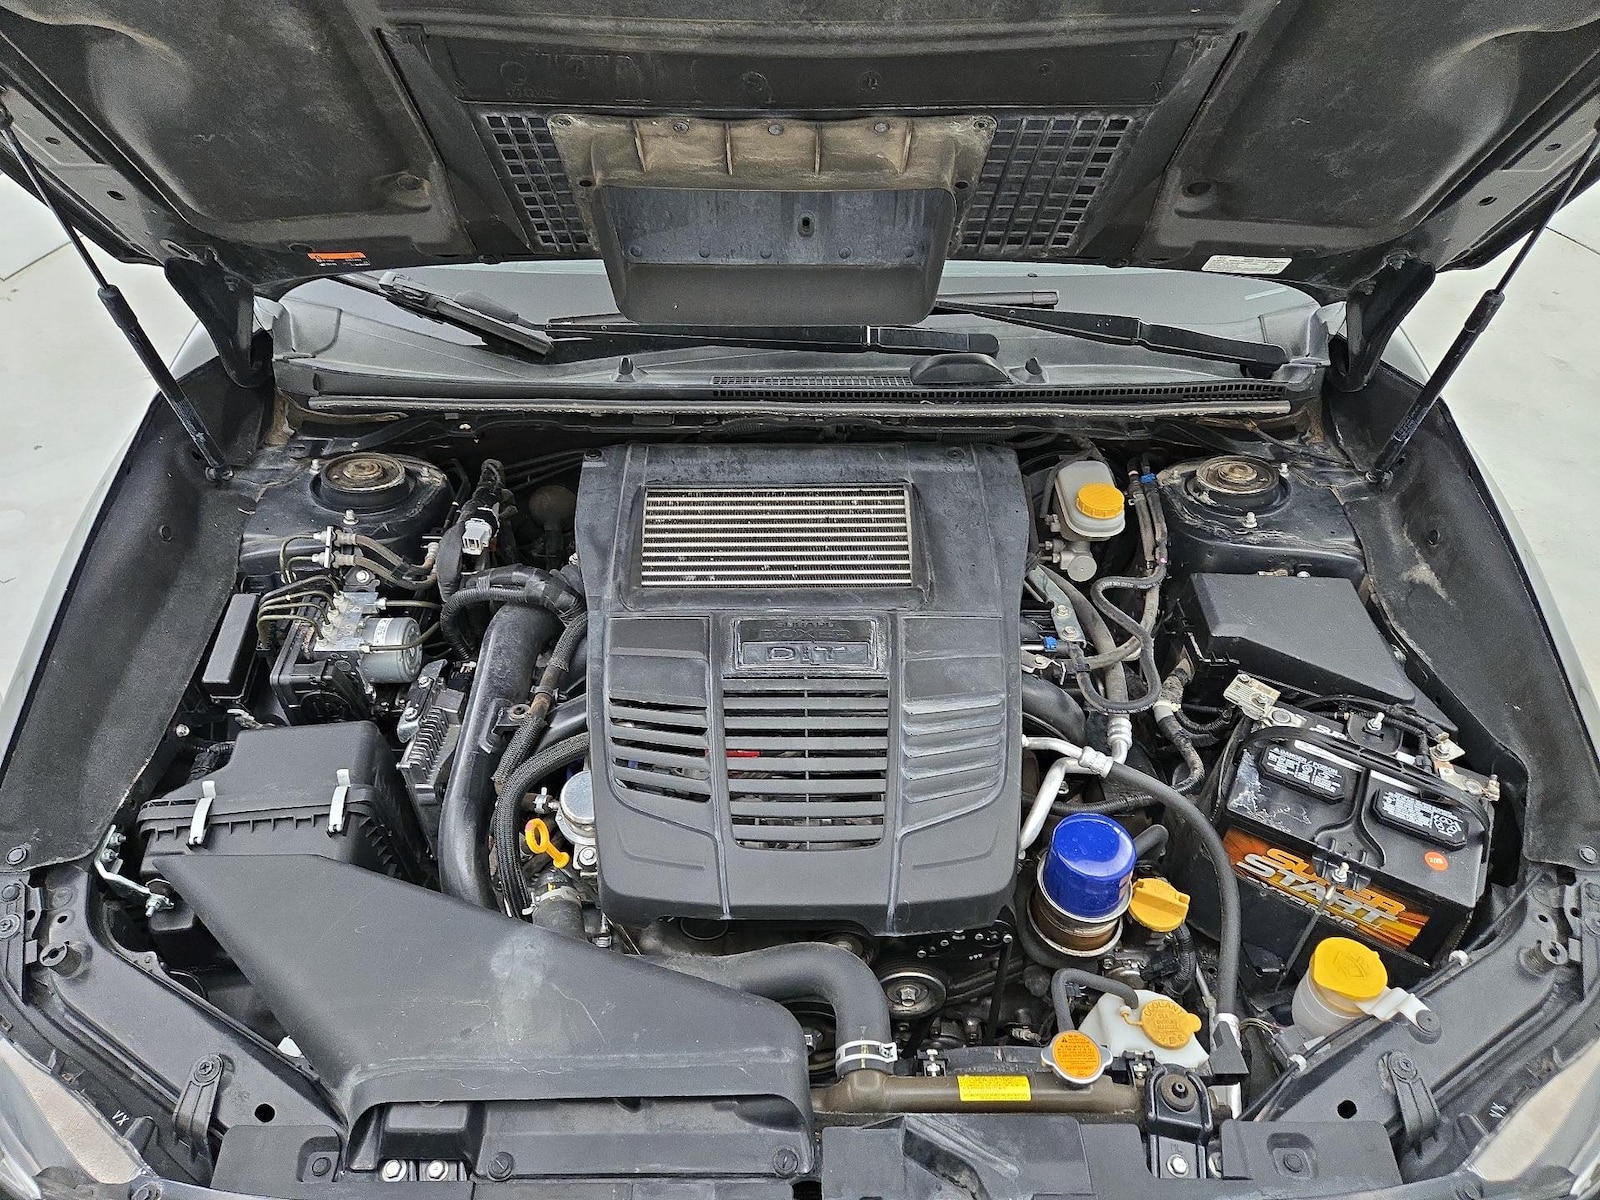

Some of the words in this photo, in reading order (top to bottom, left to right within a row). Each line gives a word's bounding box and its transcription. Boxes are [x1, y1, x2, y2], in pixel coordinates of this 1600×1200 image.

[760, 629, 852, 640] BOXER
[1280, 749, 1308, 764] DANGER
[1236, 853, 1399, 924] START
[1261, 848, 1406, 916] SUER
[1143, 1001, 1184, 1016] COOLANT
